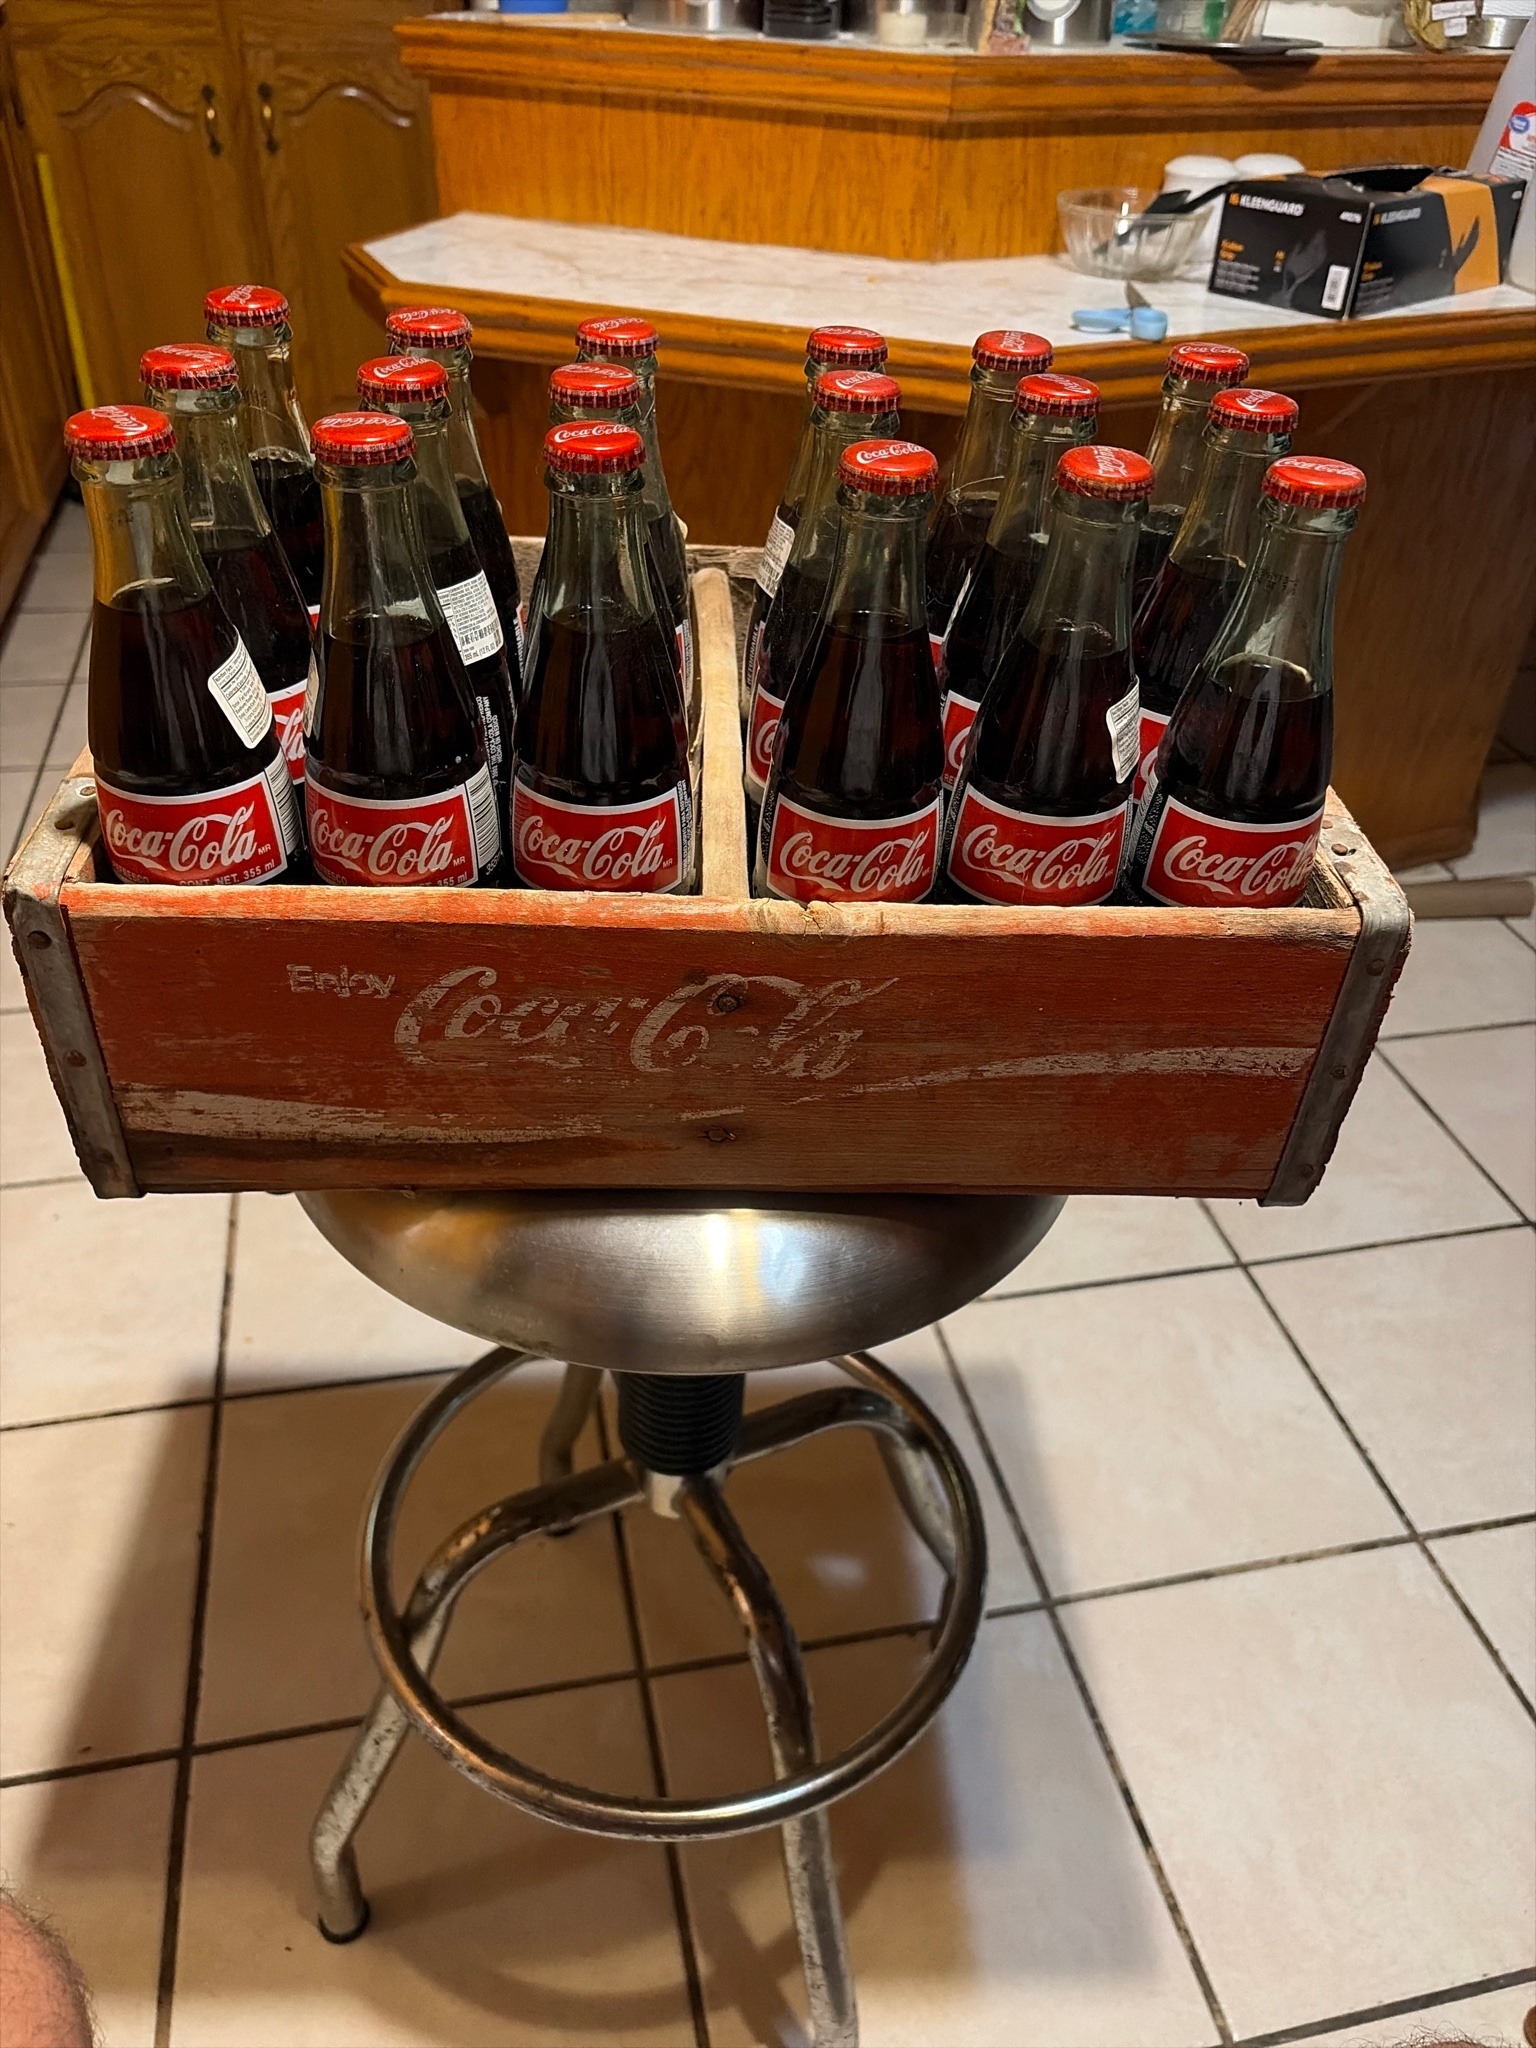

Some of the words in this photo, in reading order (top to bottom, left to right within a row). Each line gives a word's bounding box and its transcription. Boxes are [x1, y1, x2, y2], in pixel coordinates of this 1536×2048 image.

[106, 801, 257, 872] Coca-Cola
[257, 843, 271, 856] MR
[311, 808, 455, 876] Coca-Cola
[453, 855, 466, 867] MR
[518, 815, 667, 880] Coca-Cola
[662, 856, 673, 870] MR
[779, 827, 931, 893] Coca-Cola
[962, 823, 1117, 889] Coca-Cola
[1163, 832, 1320, 896] Coca-Cola
[243, 865, 262, 881] 355
[264, 861, 275, 873] ml
[457, 870, 468, 882] ml
[286, 964, 396, 1000] Enjoy
[394, 966, 899, 1080] Coca-Cla
